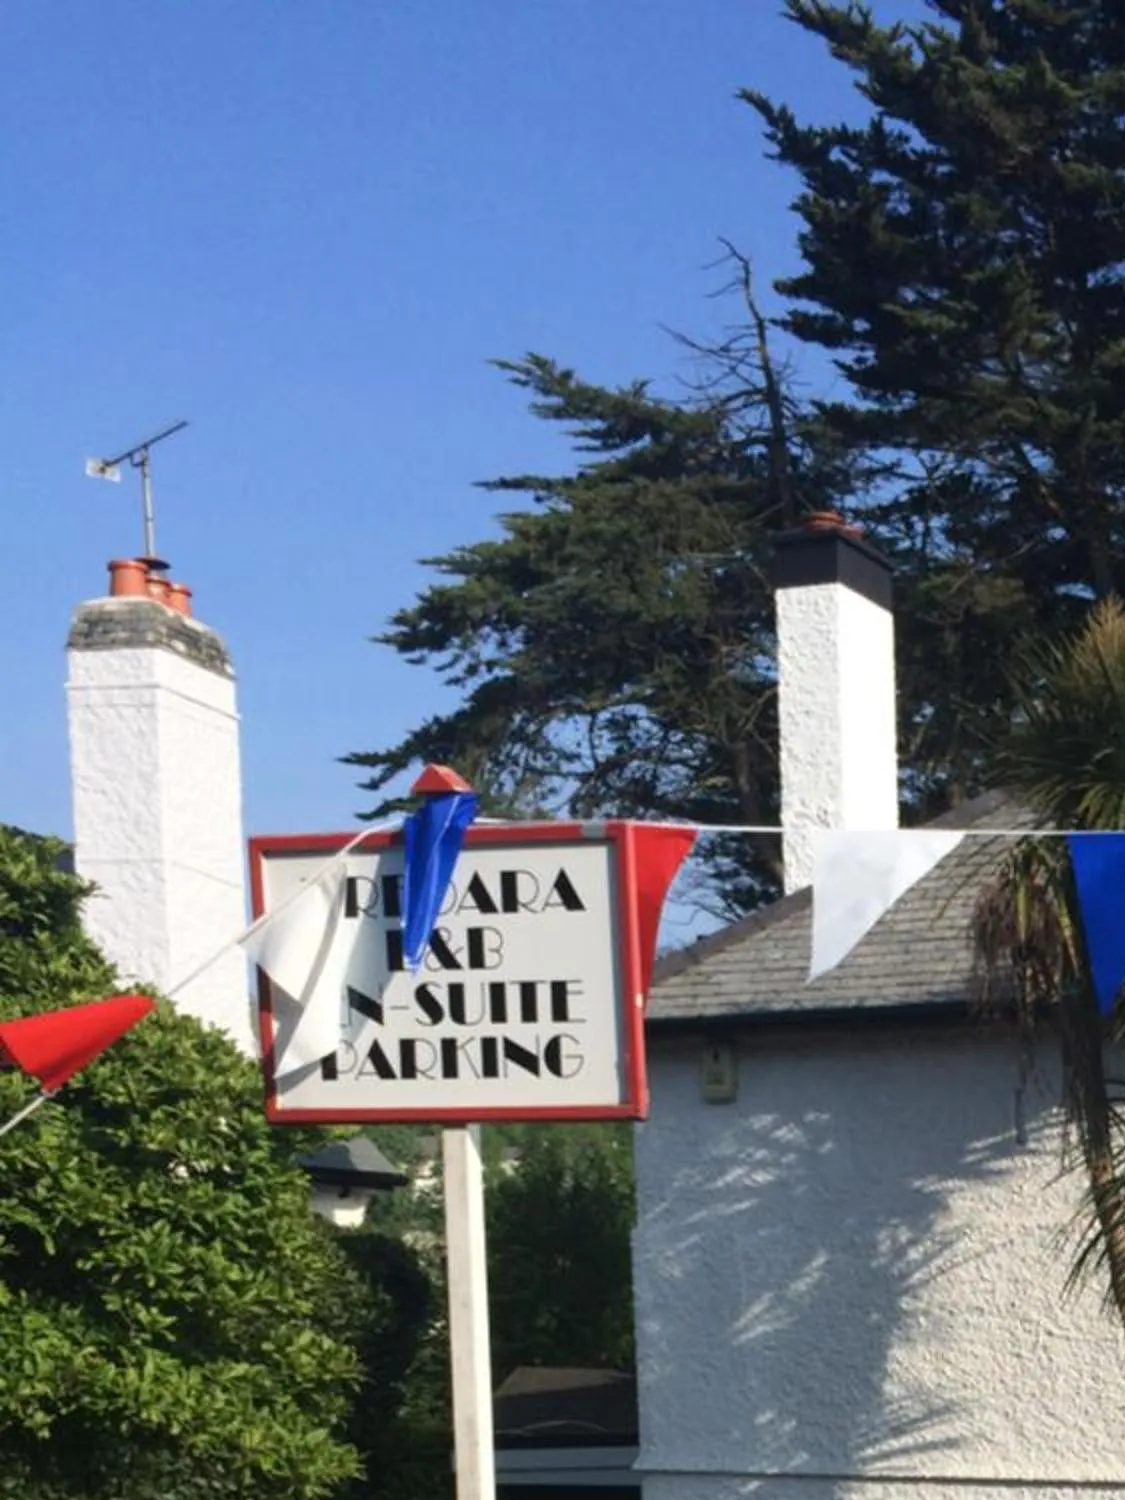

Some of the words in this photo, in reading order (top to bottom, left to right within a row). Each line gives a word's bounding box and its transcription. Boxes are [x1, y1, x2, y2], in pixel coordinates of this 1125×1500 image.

[344, 867, 586, 919] REARA
[340, 979, 586, 1027] N-SUITE
[320, 1034, 585, 1081] PARKING
